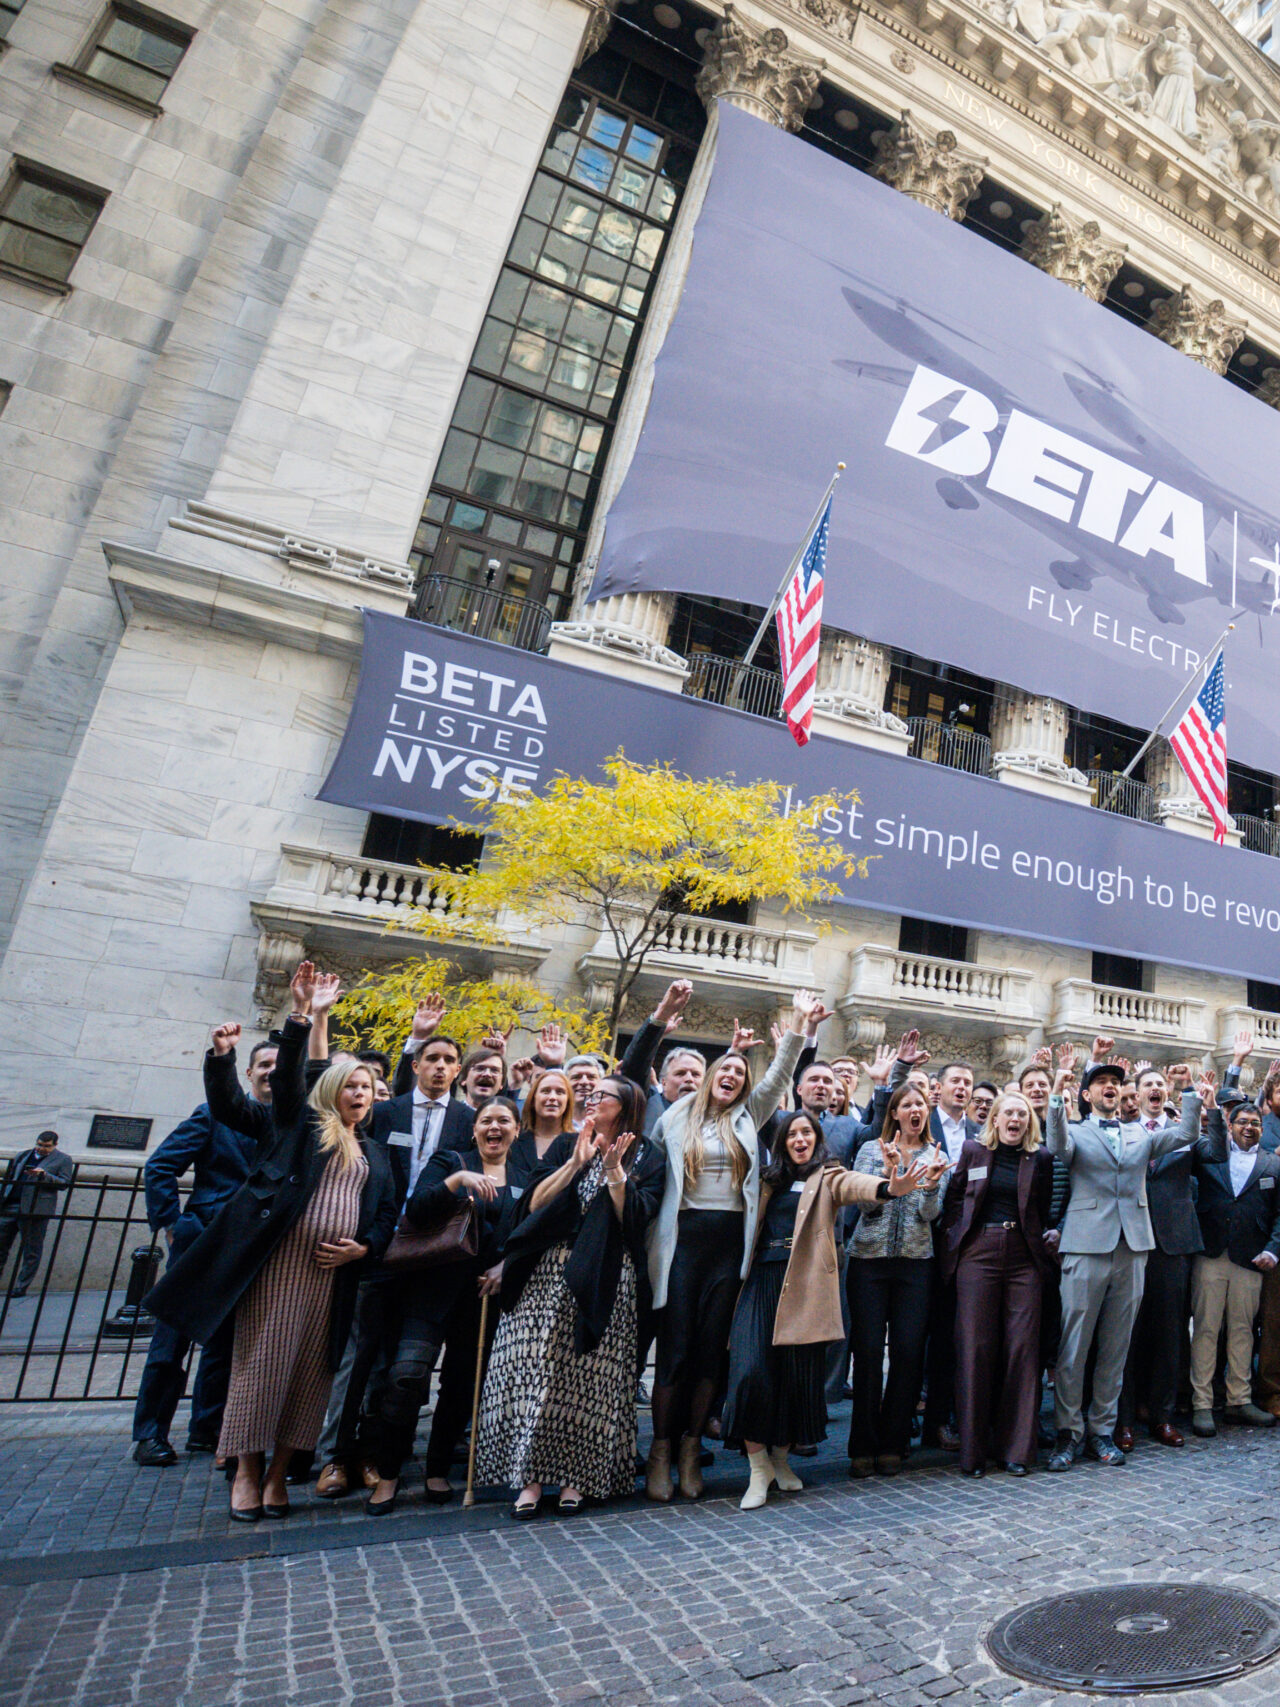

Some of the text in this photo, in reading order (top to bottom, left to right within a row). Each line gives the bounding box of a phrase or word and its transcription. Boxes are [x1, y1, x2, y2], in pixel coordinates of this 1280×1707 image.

[944, 80, 1008, 131] NEW
[1026, 131, 1101, 195] YORK
[1117, 194, 1199, 260] STOCK
[884, 364, 1208, 587] BETA
[401, 651, 548, 726] BETA
[1028, 586, 1232, 689] FLY ELECTRI
[372, 738, 539, 807] NYSE
[389, 703, 544, 758] LISTED
[874, 814, 1000, 870] simple
[1012, 851, 1134, 905] enough
[1144, 875, 1174, 908] to
[1184, 881, 1217, 918] be
